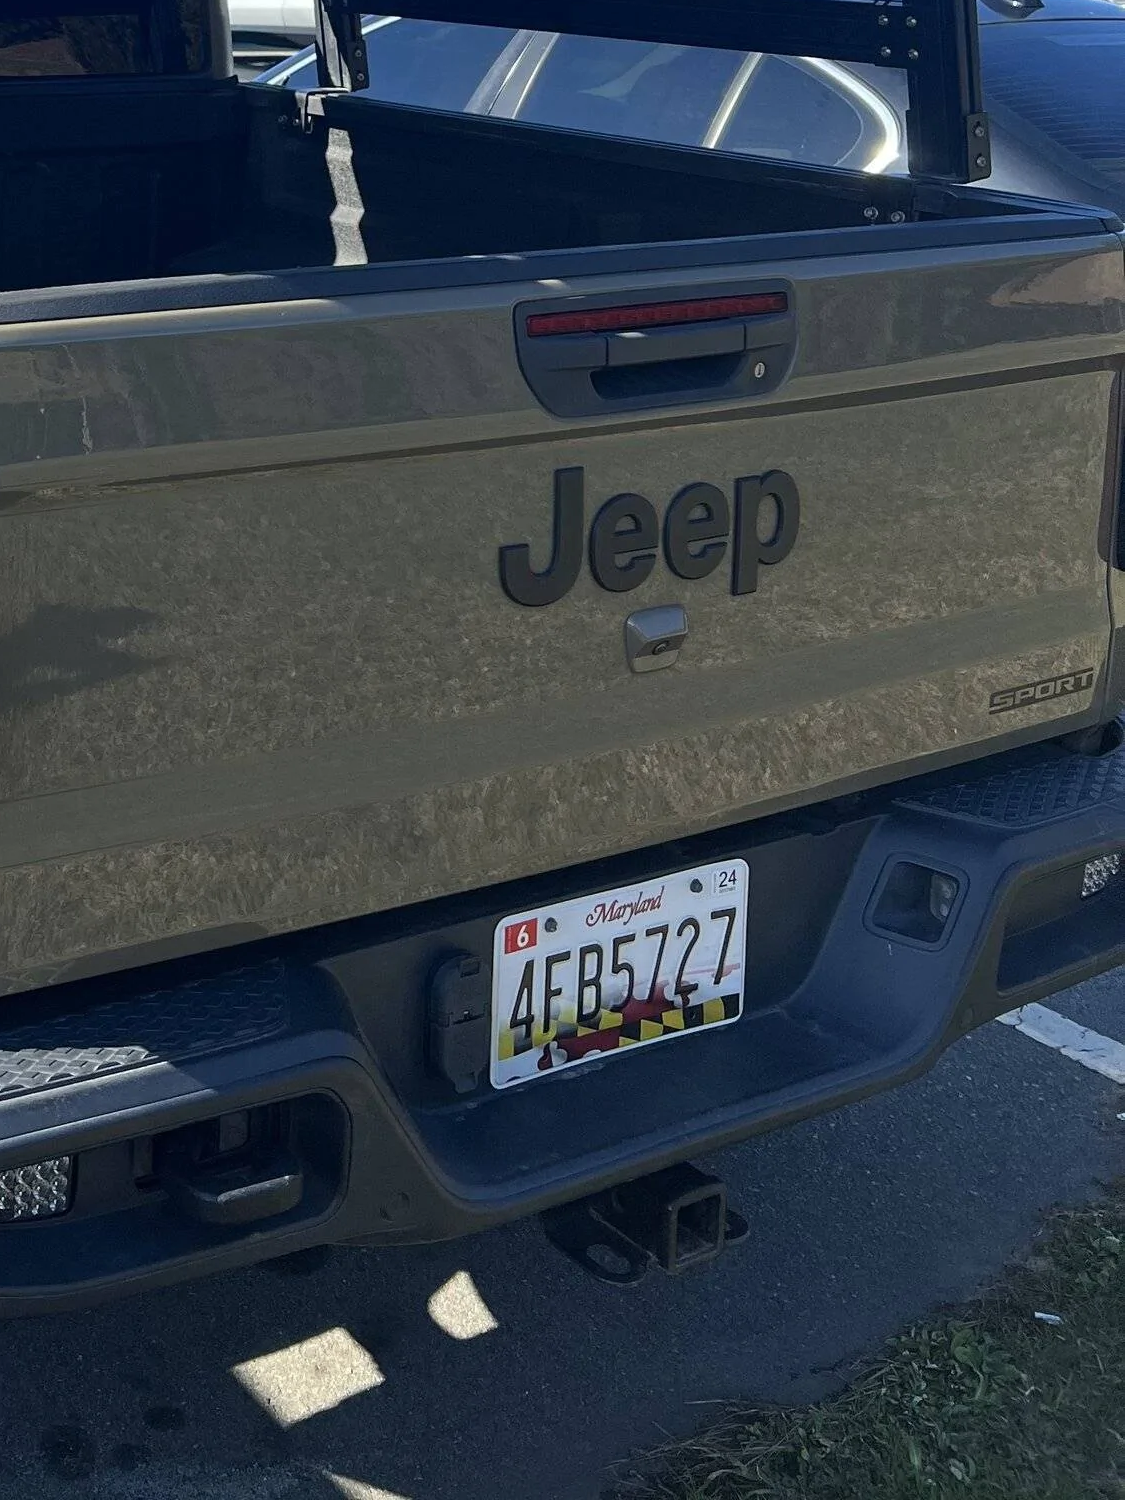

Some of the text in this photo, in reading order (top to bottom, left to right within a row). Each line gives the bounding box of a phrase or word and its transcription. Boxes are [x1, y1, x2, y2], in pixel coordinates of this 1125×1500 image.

[498, 465, 801, 608] Jeep
[989, 668, 1095, 713] SPORT
[719, 868, 737, 888] 24
[586, 885, 665, 927] Maryland
[517, 924, 529, 948] 6
[509, 906, 737, 1043] 4FB5727
